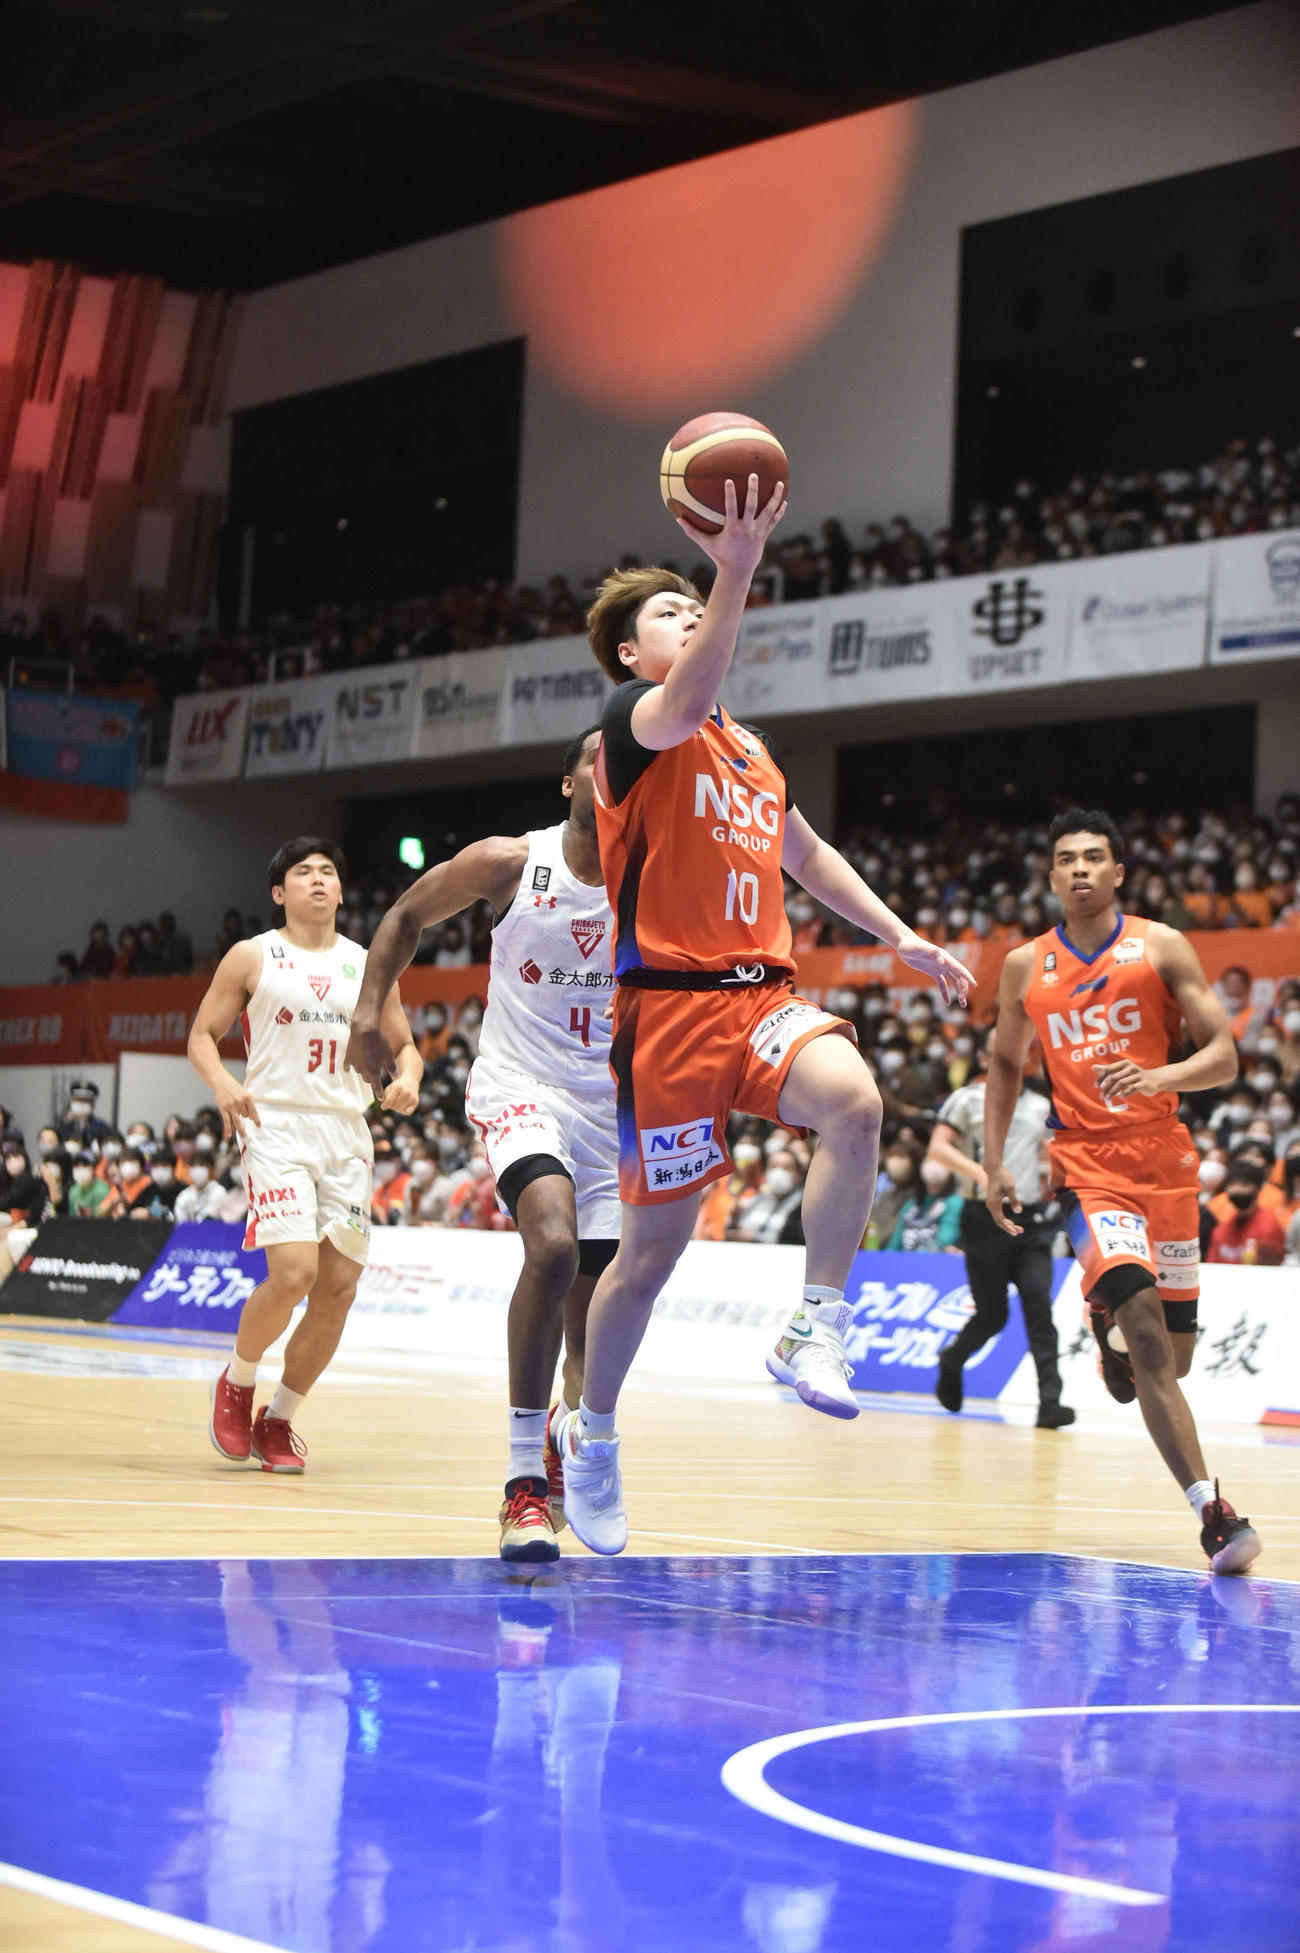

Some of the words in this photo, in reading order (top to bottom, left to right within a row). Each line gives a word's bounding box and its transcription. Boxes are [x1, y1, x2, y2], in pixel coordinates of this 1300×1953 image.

[336, 680, 408, 720] NST
[694, 773, 779, 836] NSG
[712, 826, 771, 852] GROUP
[725, 868, 759, 925] 10
[569, 1007, 591, 1048] 4
[1047, 998, 1142, 1049] NSG
[307, 1038, 337, 1075] 31
[1070, 1038, 1131, 1062] GROUP
[650, 1124, 714, 1153] NCT
[1100, 1215, 1143, 1230] NCT
